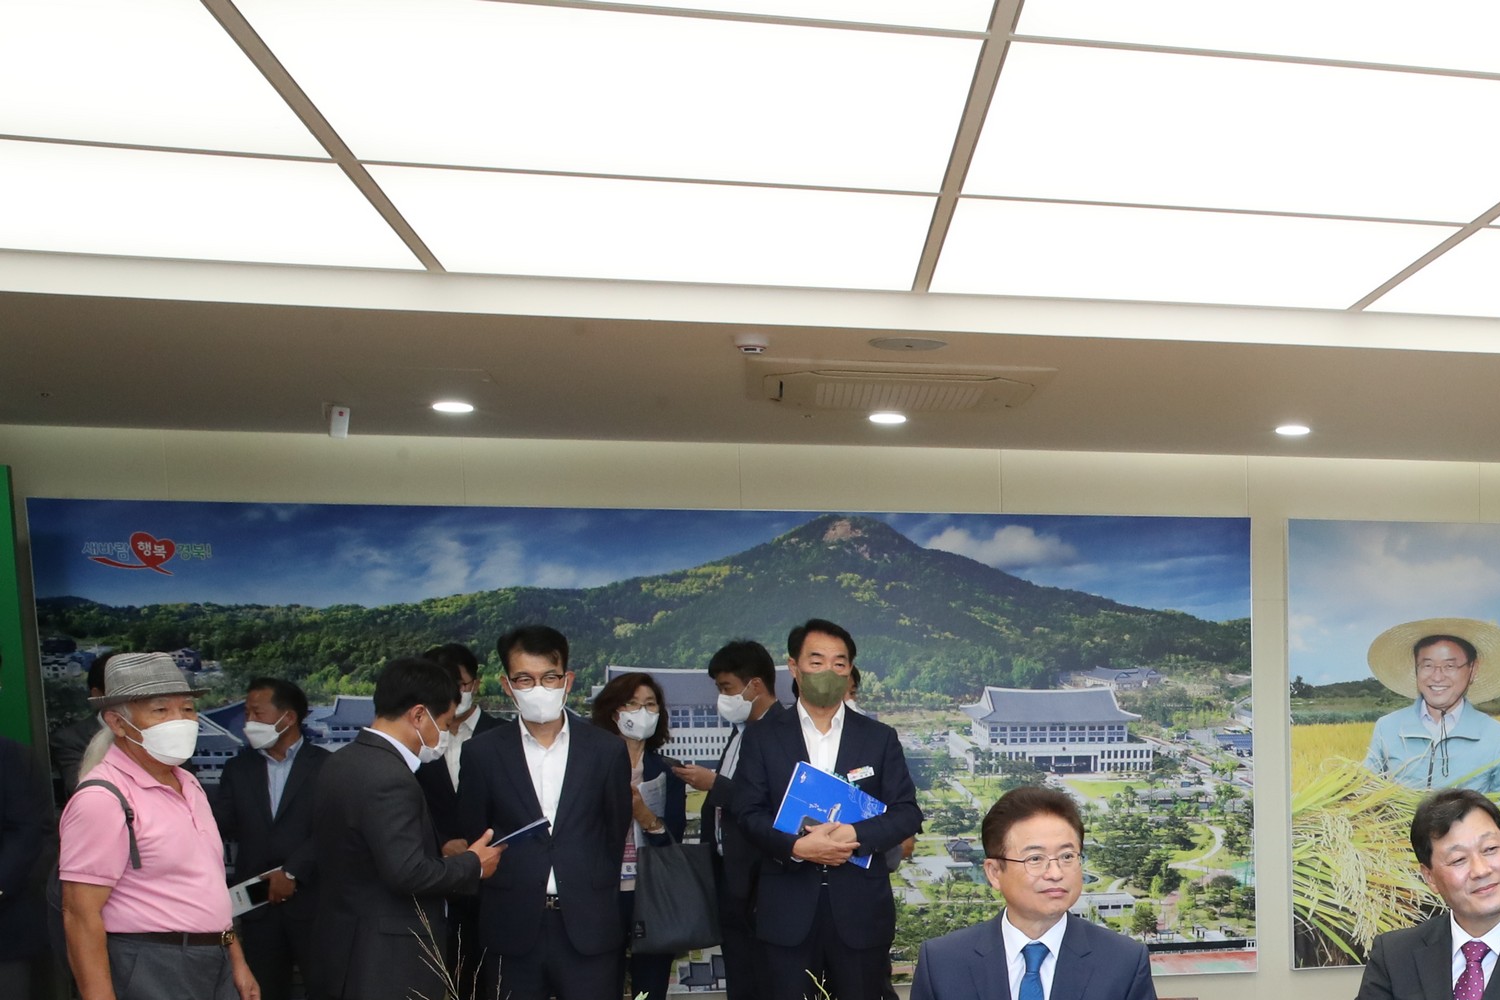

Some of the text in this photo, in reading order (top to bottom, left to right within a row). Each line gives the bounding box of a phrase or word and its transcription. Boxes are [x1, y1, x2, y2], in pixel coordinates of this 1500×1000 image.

[82, 541, 213, 561] 새바람 행복 경북!
